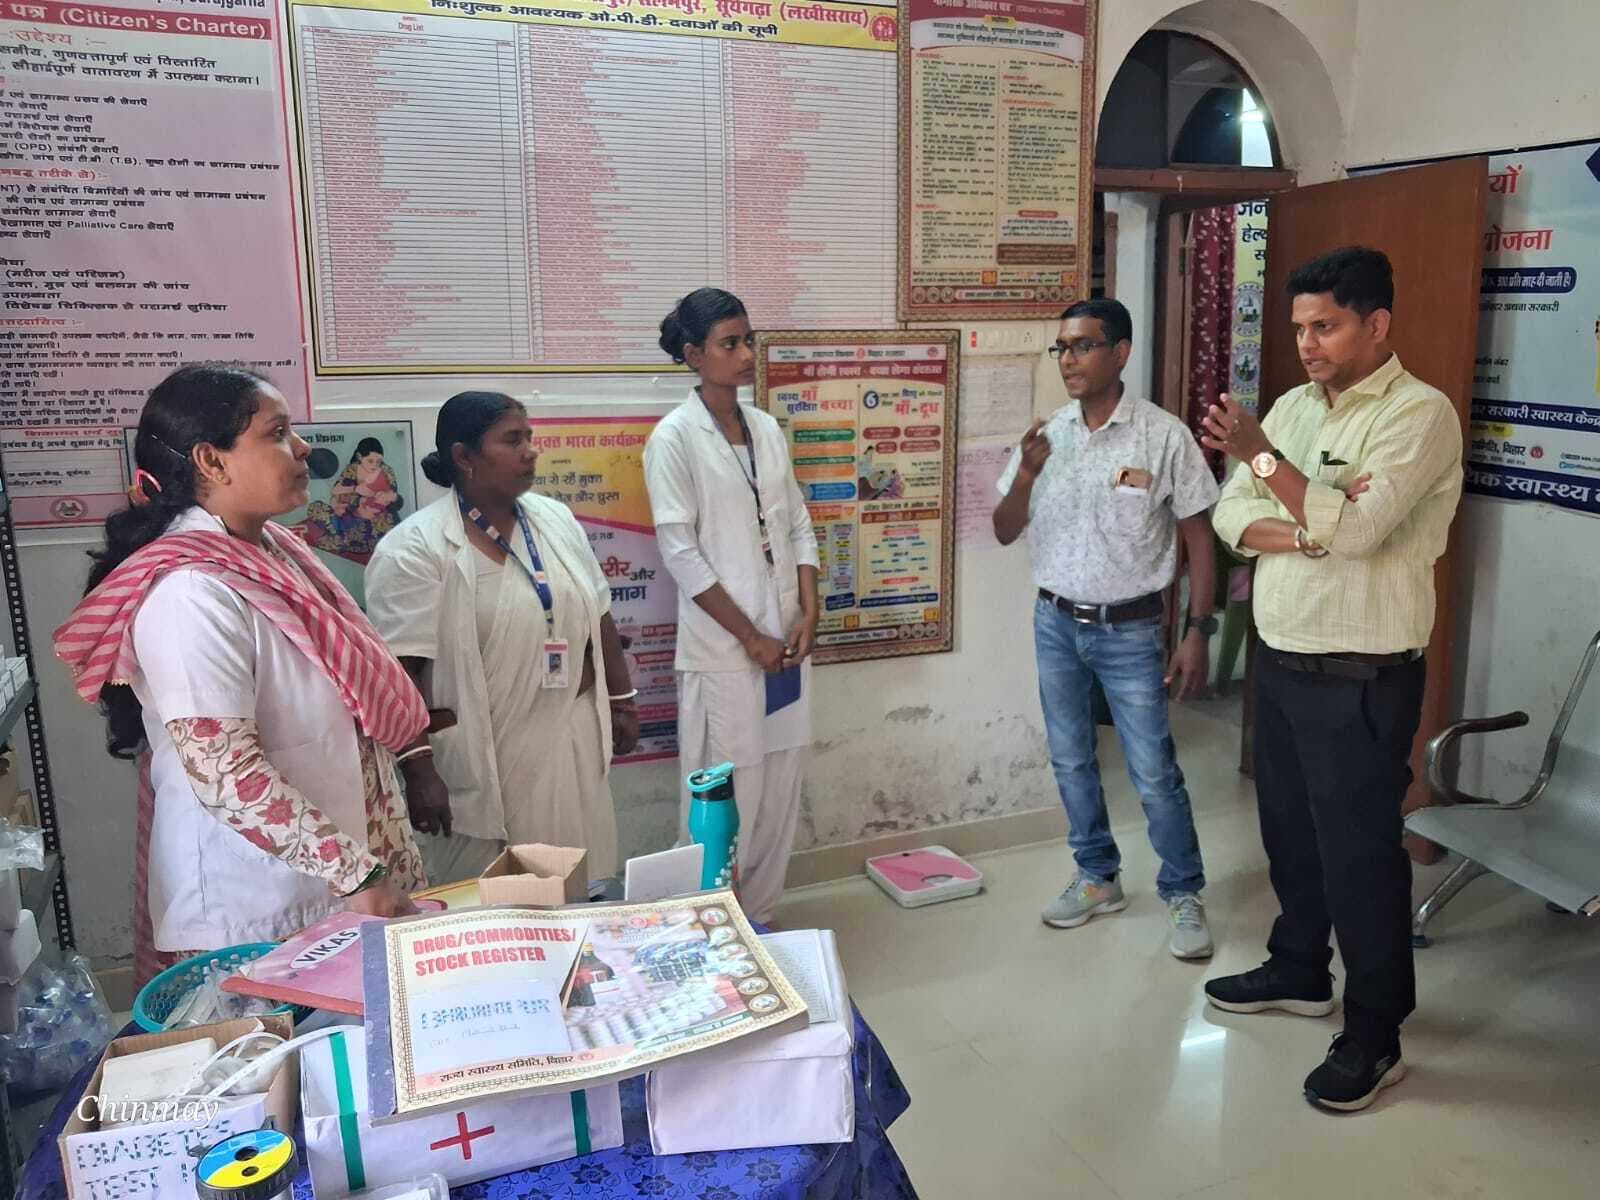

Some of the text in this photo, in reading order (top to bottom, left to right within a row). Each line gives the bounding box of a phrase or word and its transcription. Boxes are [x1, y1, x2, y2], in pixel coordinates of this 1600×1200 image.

[11, 4, 265, 38] पत्र (Citizen's Charter)
[508, 5, 584, 20] आवश्यक
[722, 21, 744, 33] की
[747, 24, 778, 38] सूची
[780, 1, 869, 28] (लखीसराय)
[398, 23, 412, 32] Drug
[134, 54, 152, 64] एवं
[158, 55, 217, 69] विस्तारित
[82, 67, 141, 79] वातावरण
[147, 68, 159, 79] में
[15, 143, 52, 153] (OPD)
[67, 220, 116, 231] Palliative
[119, 222, 144, 232] Care
[1528, 300, 1560, 312] सरकारी
[1487, 404, 1529, 419] सरकारी
[1530, 411, 1574, 424] स्वास्थ्य
[566, 435, 596, 449] भारत
[1503, 441, 1527, 457] बिहार
[1503, 475, 1592, 502] स्वास्थ्य
[599, 556, 656, 582] रीर और
[609, 585, 648, 602] माग
[296, 930, 359, 962] VIKAS
[413, 928, 577, 956] DRUG/COMMODITIES/
[415, 947, 546, 977] STOCK REGISTER
[467, 1063, 504, 1076] स्वास्थ्य
[508, 1058, 545, 1072] समिति,
[547, 1053, 574, 1065] बिहार
